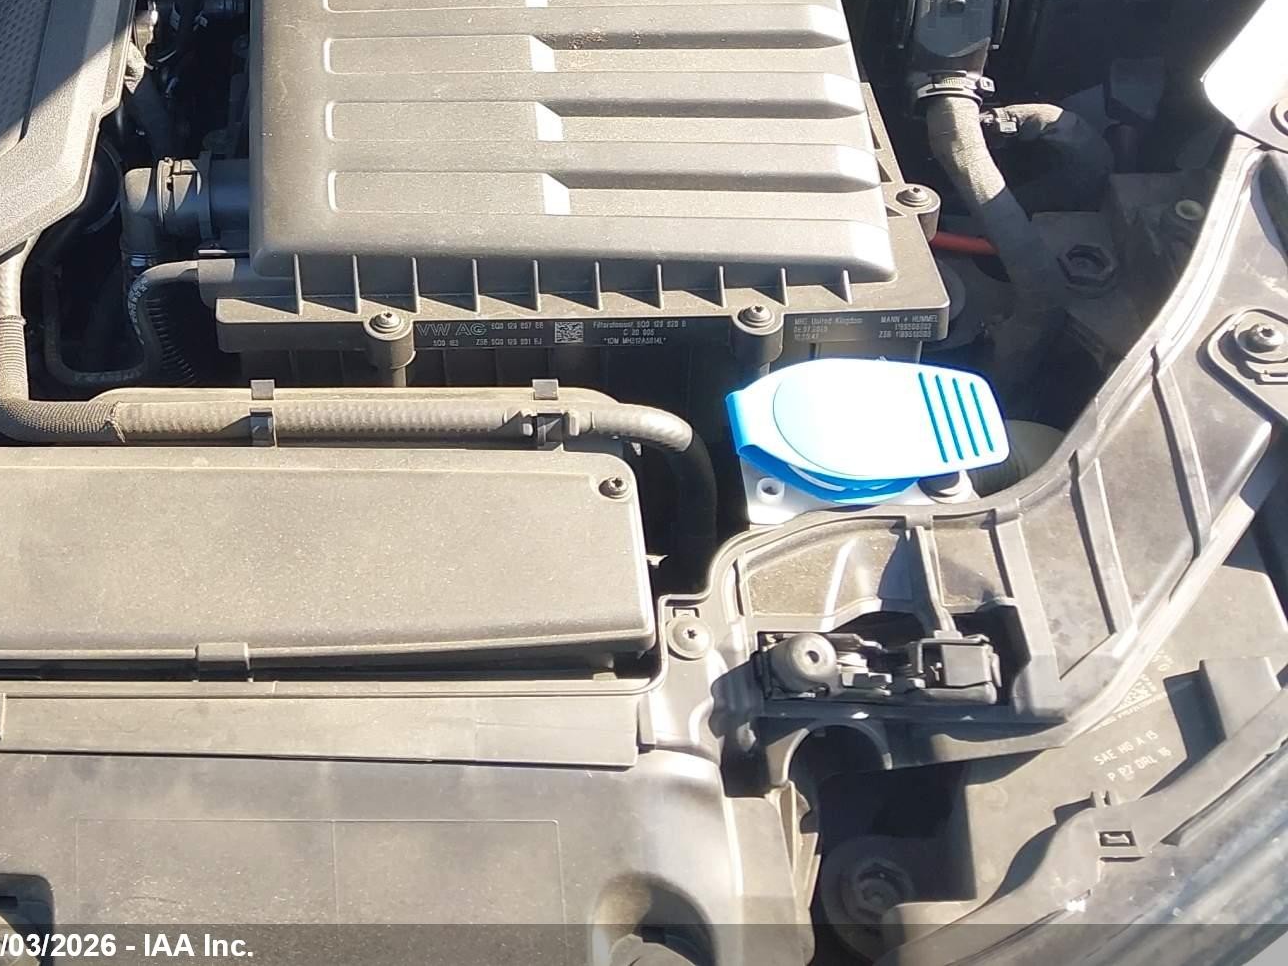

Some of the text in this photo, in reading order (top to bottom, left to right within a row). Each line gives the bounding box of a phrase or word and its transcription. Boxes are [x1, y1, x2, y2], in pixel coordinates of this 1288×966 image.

[416, 322, 487, 336] VW AG
[1093, 749, 1118, 766] SAE
[1135, 737, 1146, 746] A
